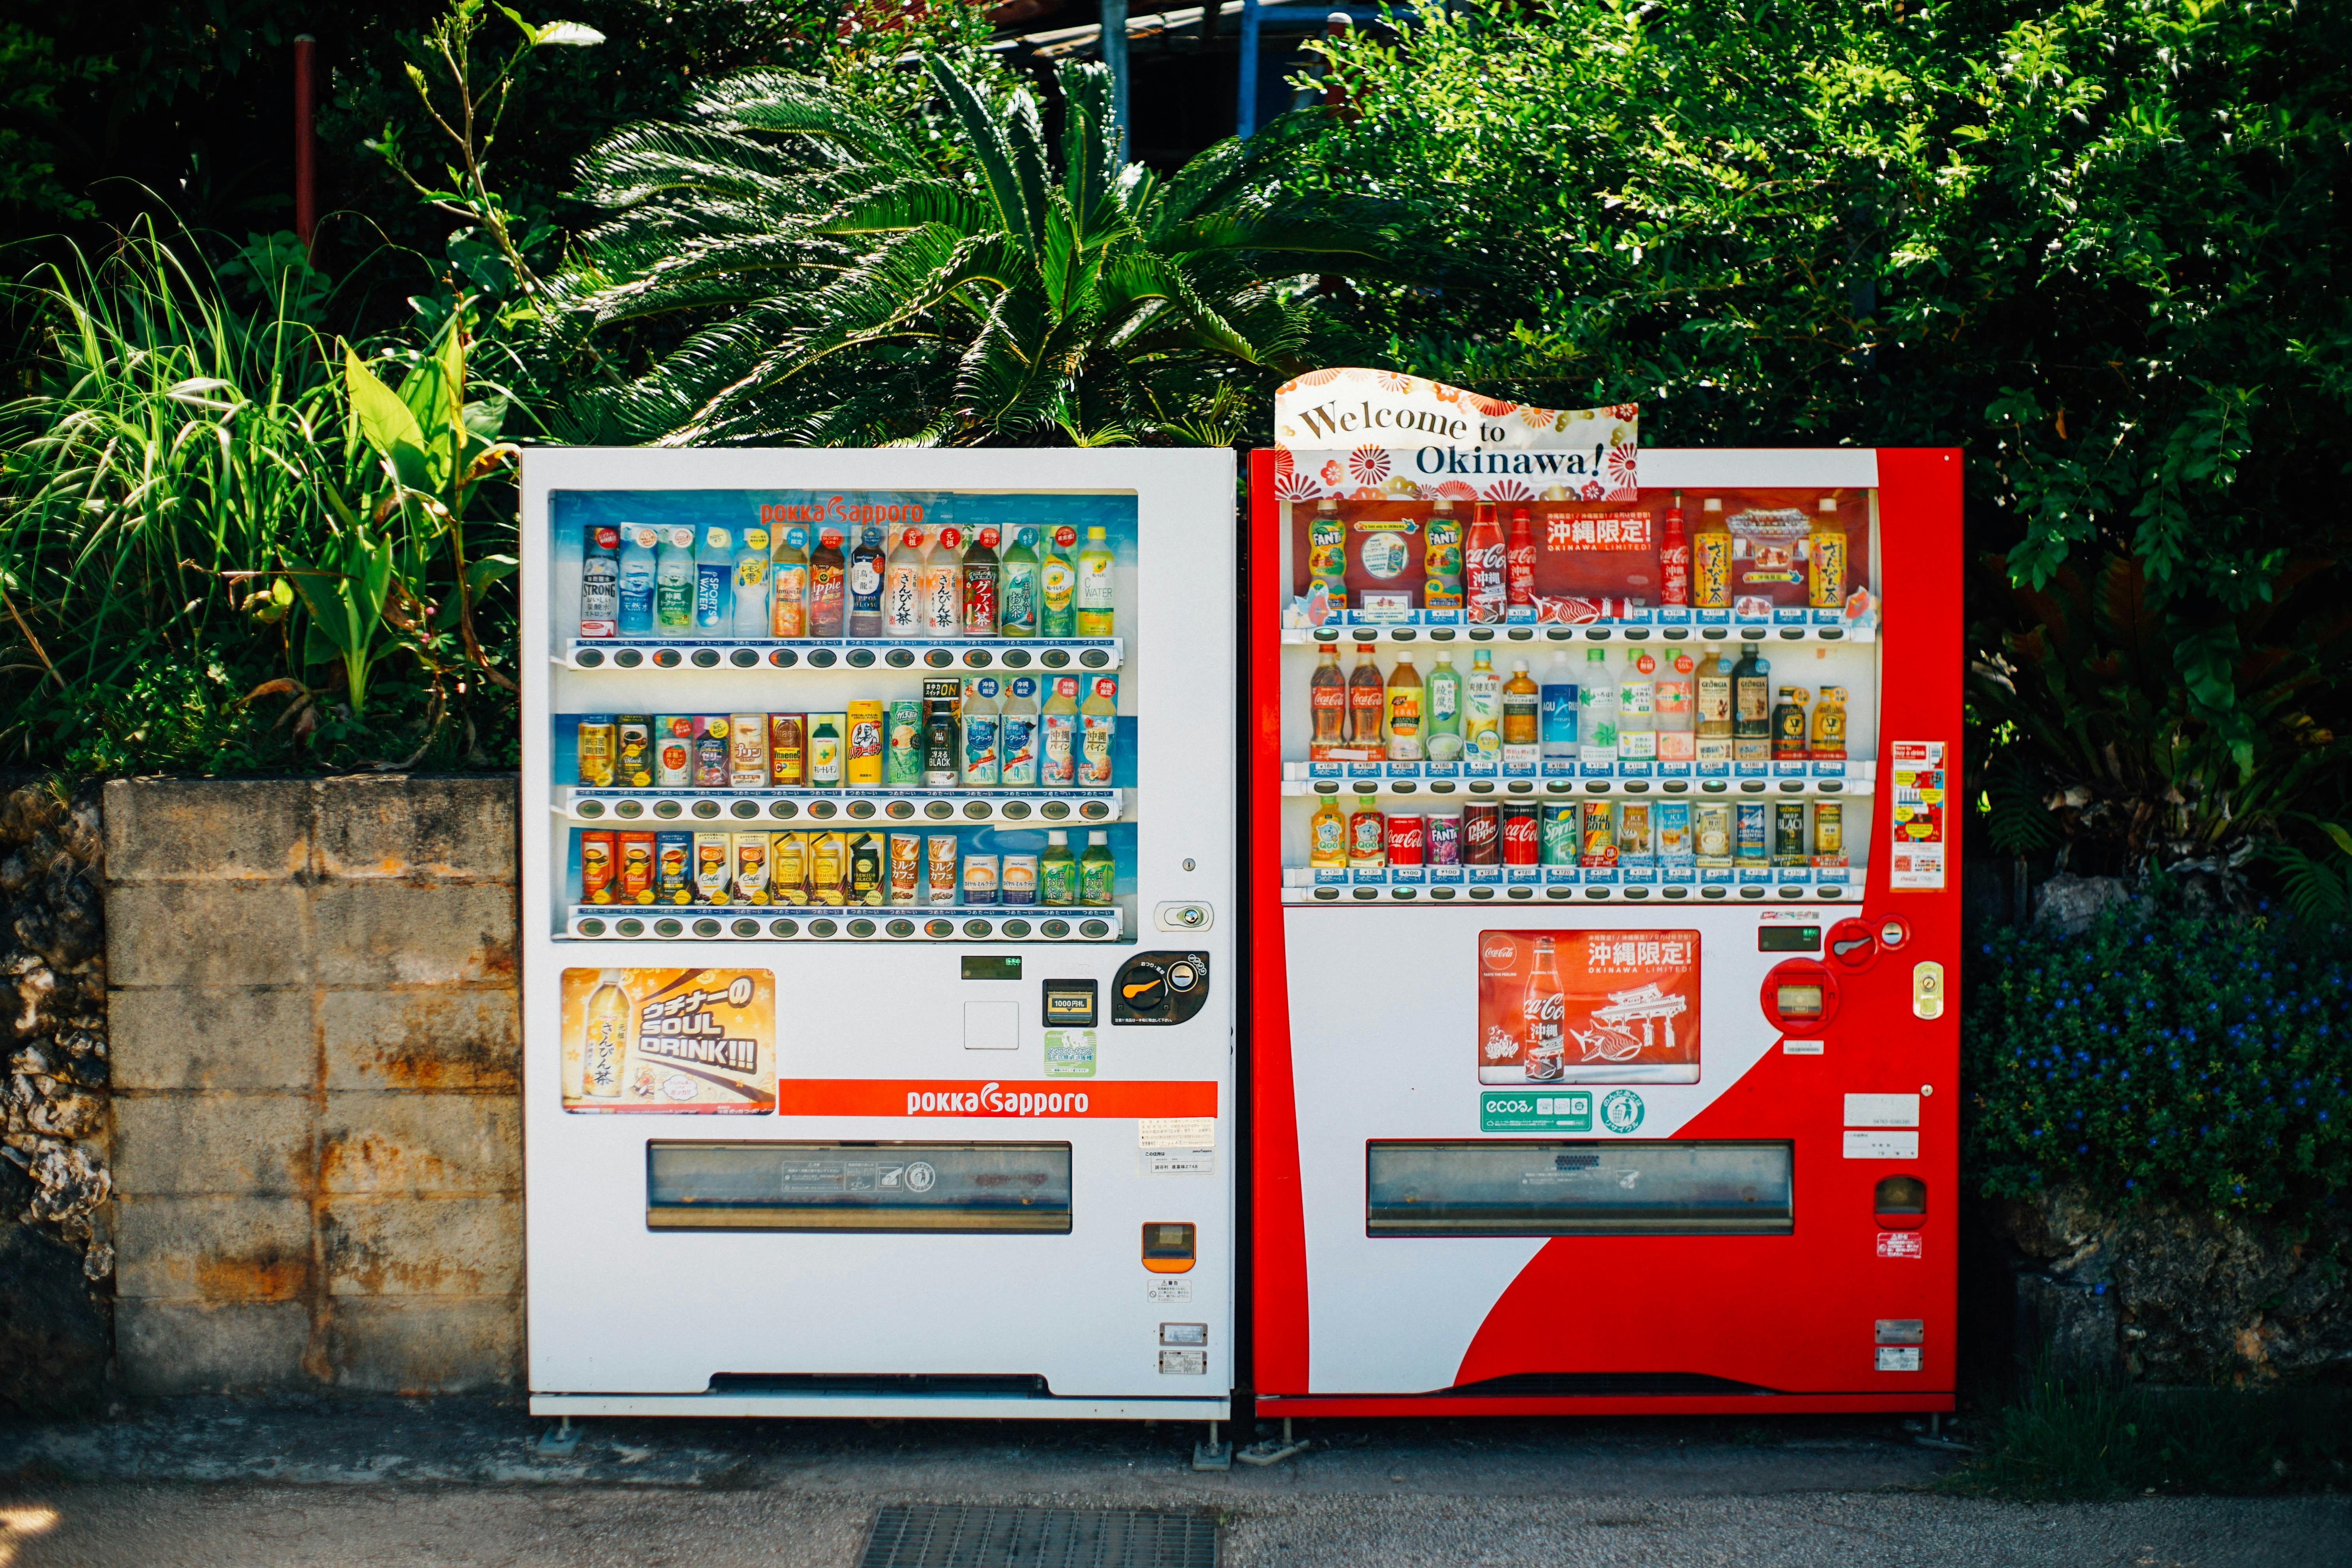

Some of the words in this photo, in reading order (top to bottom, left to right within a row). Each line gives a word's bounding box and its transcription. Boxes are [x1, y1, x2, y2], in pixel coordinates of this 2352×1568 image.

[1298, 400, 1467, 440] Welcome
[1479, 422, 1505, 442] to
[1416, 443, 1604, 476] Okinawa!
[908, 531, 916, 546] 元祖
[946, 531, 954, 547] 元祖
[984, 533, 989, 544] 健康
[991, 533, 996, 544] 毎日
[1022, 535, 1028, 544] 香り
[746, 573, 756, 584] 雫
[1707, 541, 1723, 604] さんぴん茶
[1821, 541, 1839, 603] さんぴん茶
[913, 574, 917, 588] 元祖
[951, 575, 956, 588] 元祖
[1085, 577, 1091, 588] C
[584, 584, 615, 597] STRONG
[699, 577, 709, 610] WATER
[708, 578, 719, 616] SPORTS
[1045, 592, 1070, 601] Sparkling
[1085, 588, 1112, 597] WATER
[896, 574, 913, 626] さんぴん茶
[936, 575, 953, 627] さんぴん茶
[975, 581, 991, 627] グァバ茶
[1022, 582, 1030, 613] 玉露入り
[624, 603, 648, 611] 天然水
[1010, 592, 1022, 618] お茶
[940, 684, 957, 696] ON
[1051, 730, 1070, 740] 沖縄
[1087, 731, 1107, 741] 沖縄
[702, 753, 722, 761] ゼリー
[735, 744, 761, 758] プリン
[774, 751, 800, 759] VitaeneC
[849, 742, 882, 759] パワーギア
[929, 758, 950, 766] BLACK
[814, 765, 837, 773] キレートレモン
[1477, 820, 1490, 832] Dr
[1778, 819, 1803, 829] BLACK
[1432, 829, 1457, 842] FANTA
[1468, 824, 1497, 842] Pepper
[891, 861, 916, 871] ミルク
[929, 862, 954, 872] ミルク
[892, 871, 915, 880] カフェ
[931, 872, 953, 881] カフェ
[1047, 877, 1057, 899] お茶
[1085, 877, 1095, 898] お茶
[1485, 947, 1514, 957] Coca-Cola
[1005, 957, 1021, 966] 販売中
[644, 978, 751, 1020] ウチナーの
[641, 1013, 722, 1035] SOUL
[617, 1024, 625, 1040] 元祖
[1530, 1022, 1558, 1040] 沖縄
[593, 1022, 615, 1087] さんぴん茶
[641, 1038, 755, 1069] DRINK!!!
[1603, 1091, 1642, 1107] のんだあとは
[1605, 1120, 1639, 1133] リサイクル
